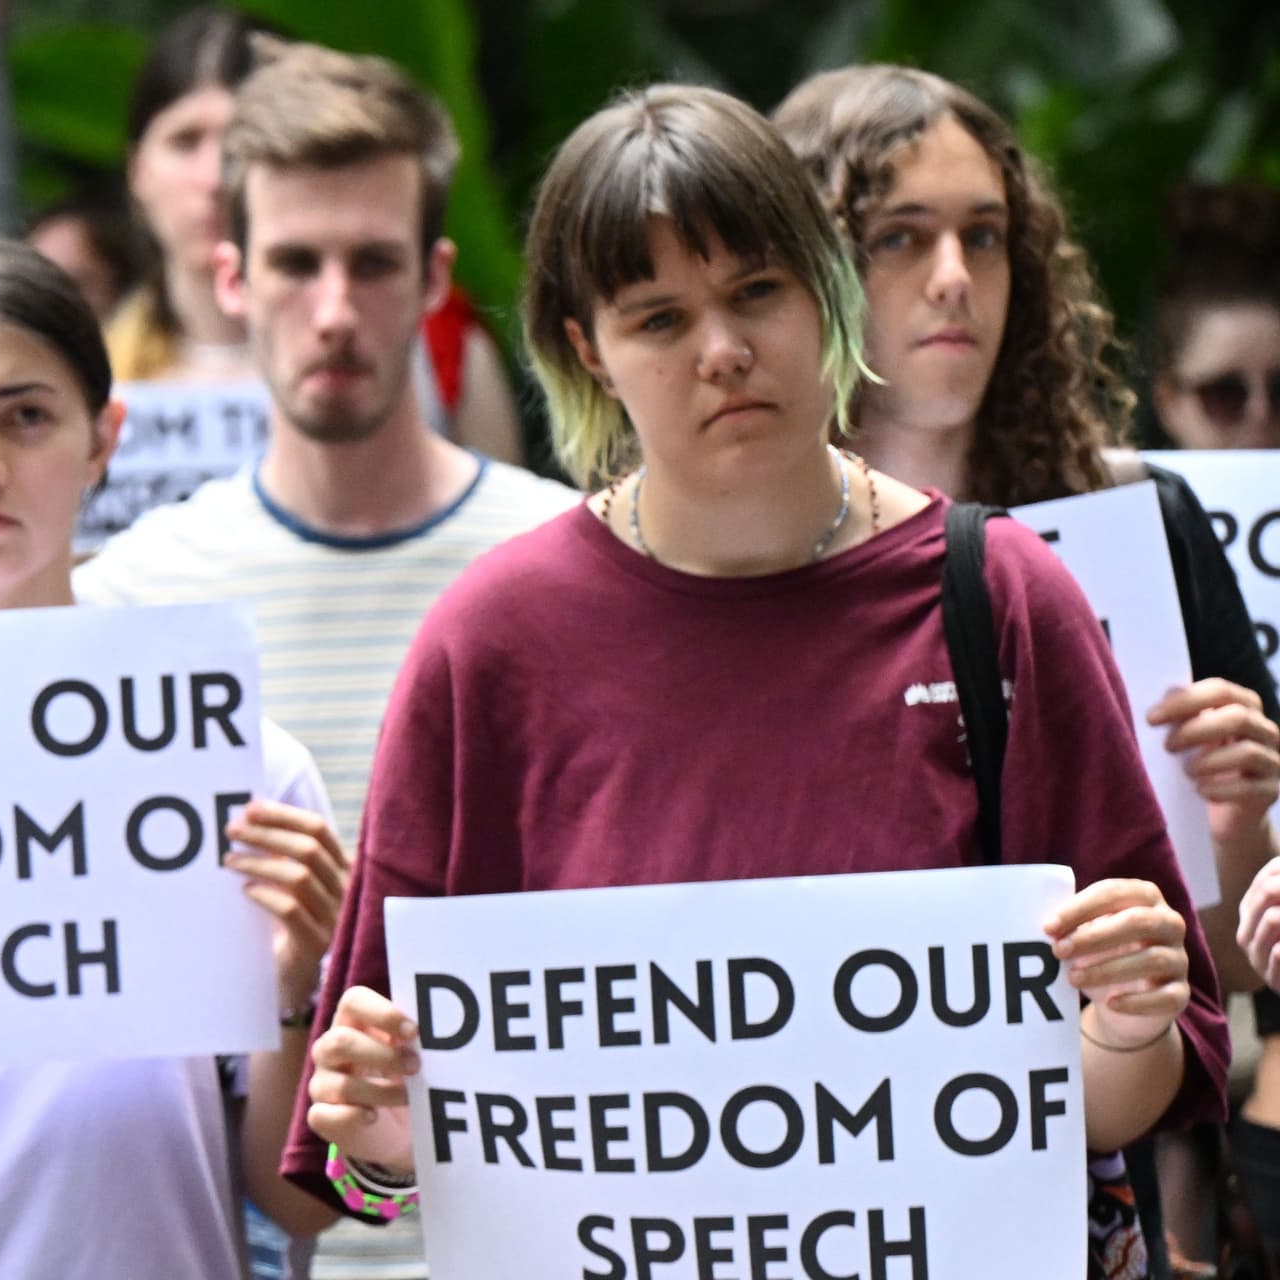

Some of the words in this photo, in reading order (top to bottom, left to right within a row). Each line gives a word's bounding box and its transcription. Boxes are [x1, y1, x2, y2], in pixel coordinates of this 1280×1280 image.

[32, 672, 247, 757] OUR
[126, 791, 253, 872] OF
[414, 957, 796, 1052] DEFEND
[833, 942, 1064, 1032] OUR
[429, 1078, 894, 1173] FREEDOM
[933, 1067, 1068, 1158] OF
